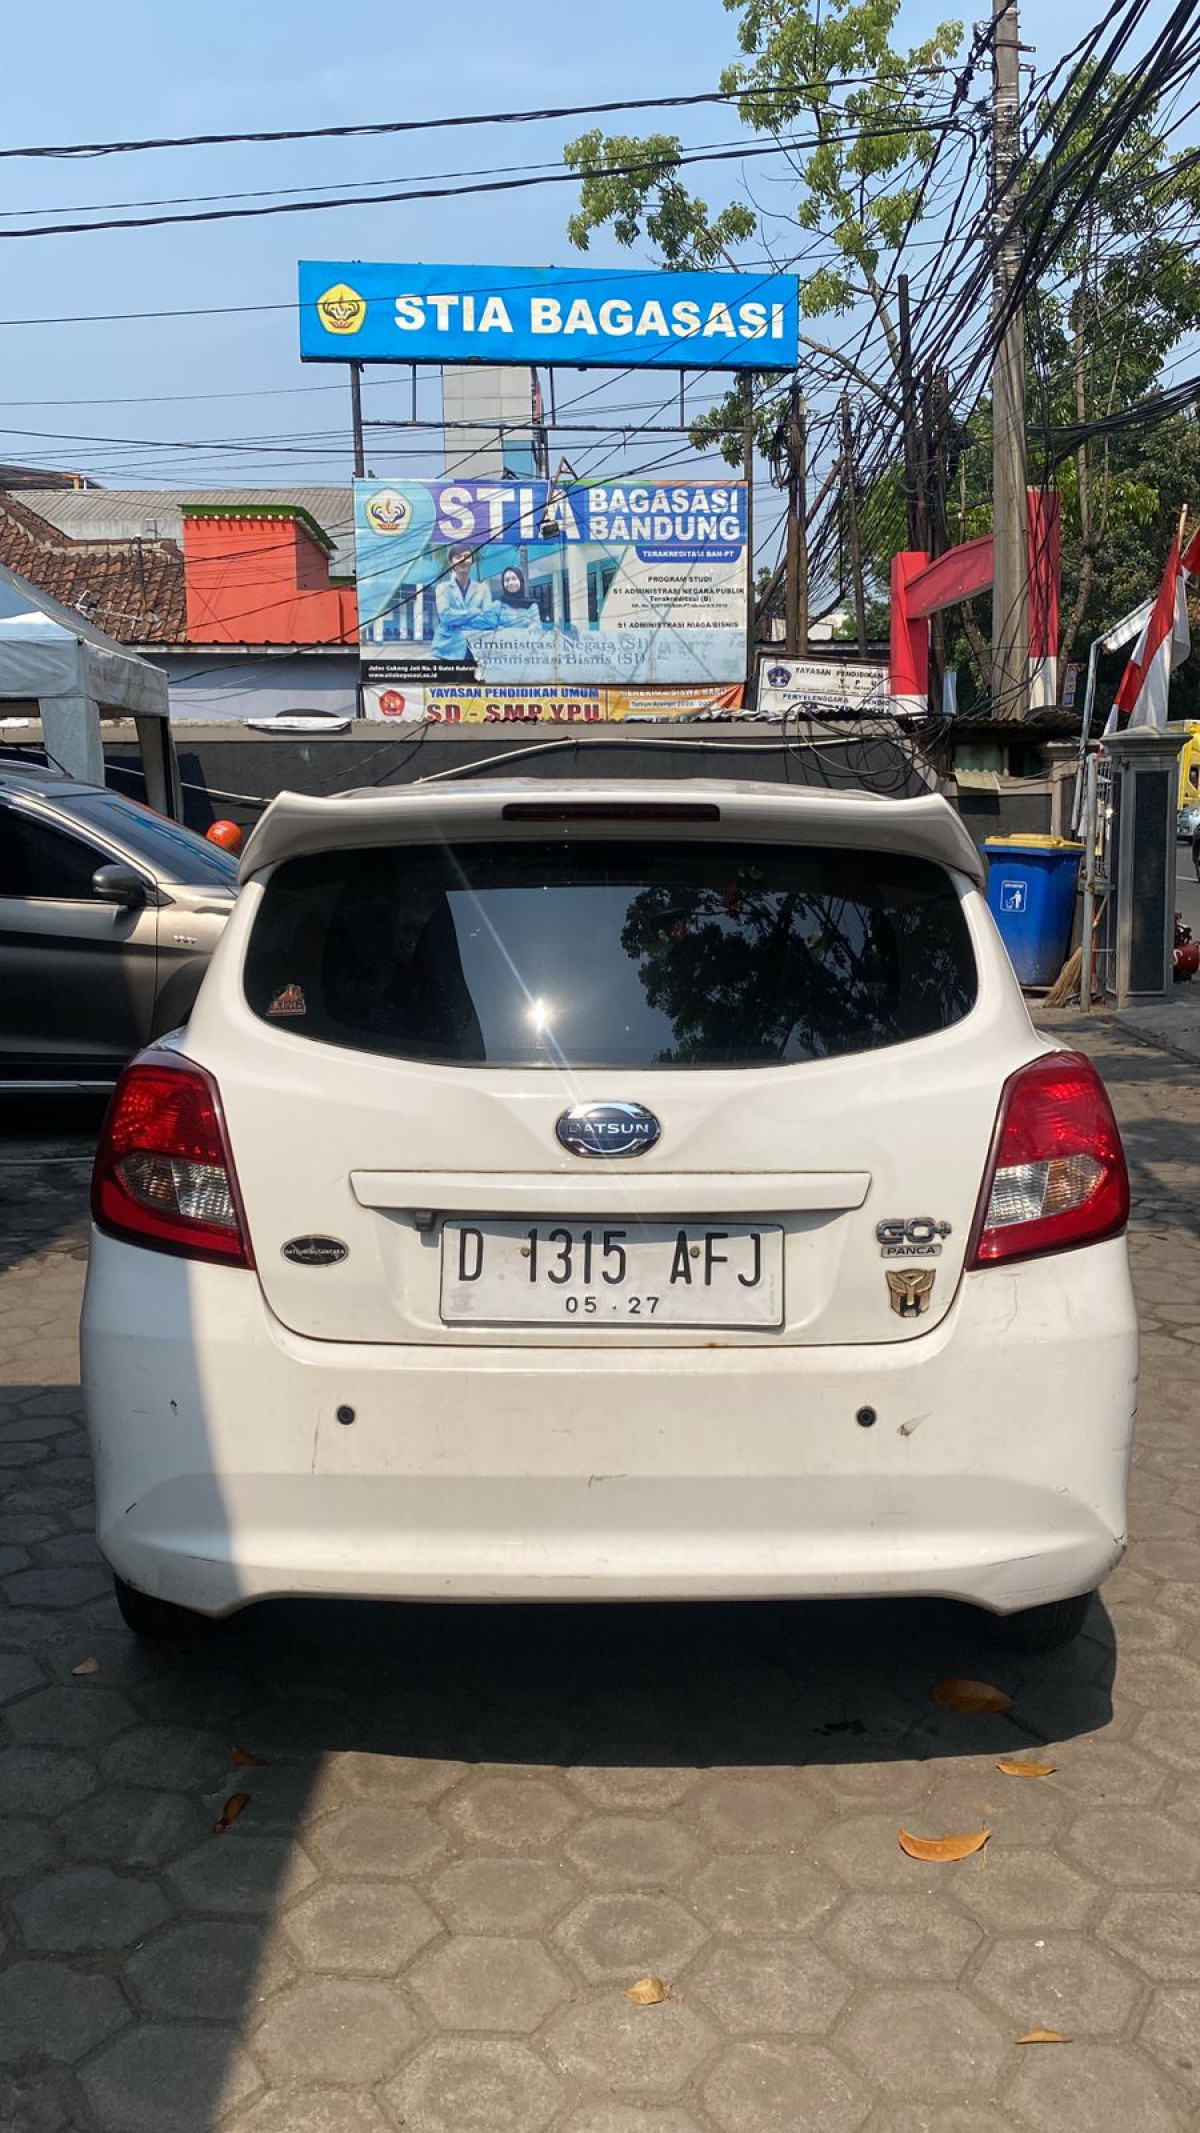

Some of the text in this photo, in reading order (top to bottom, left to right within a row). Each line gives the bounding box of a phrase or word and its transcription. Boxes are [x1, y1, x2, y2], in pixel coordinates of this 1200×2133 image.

[394, 294, 784, 340] STIA BAGASASI
[588, 488, 738, 514] BAGASASI
[438, 487, 581, 541] STIA
[589, 516, 741, 541] BANDUNG
[795, 667, 884, 679] YAYASAN PENDIDIKAN
[429, 688, 599, 698] YAYASAN PENDIDIKAN UMUM
[426, 704, 461, 722] SD
[486, 704, 543, 721] SMP
[549, 704, 600, 721] YPU
[567, 1123, 649, 1134] DATSUN
[458, 1227, 762, 1288] D 1315 AFJ
[886, 1246, 936, 1256] PANCA
[565, 1296, 598, 1314] 05
[628, 1296, 661, 1314] 27
